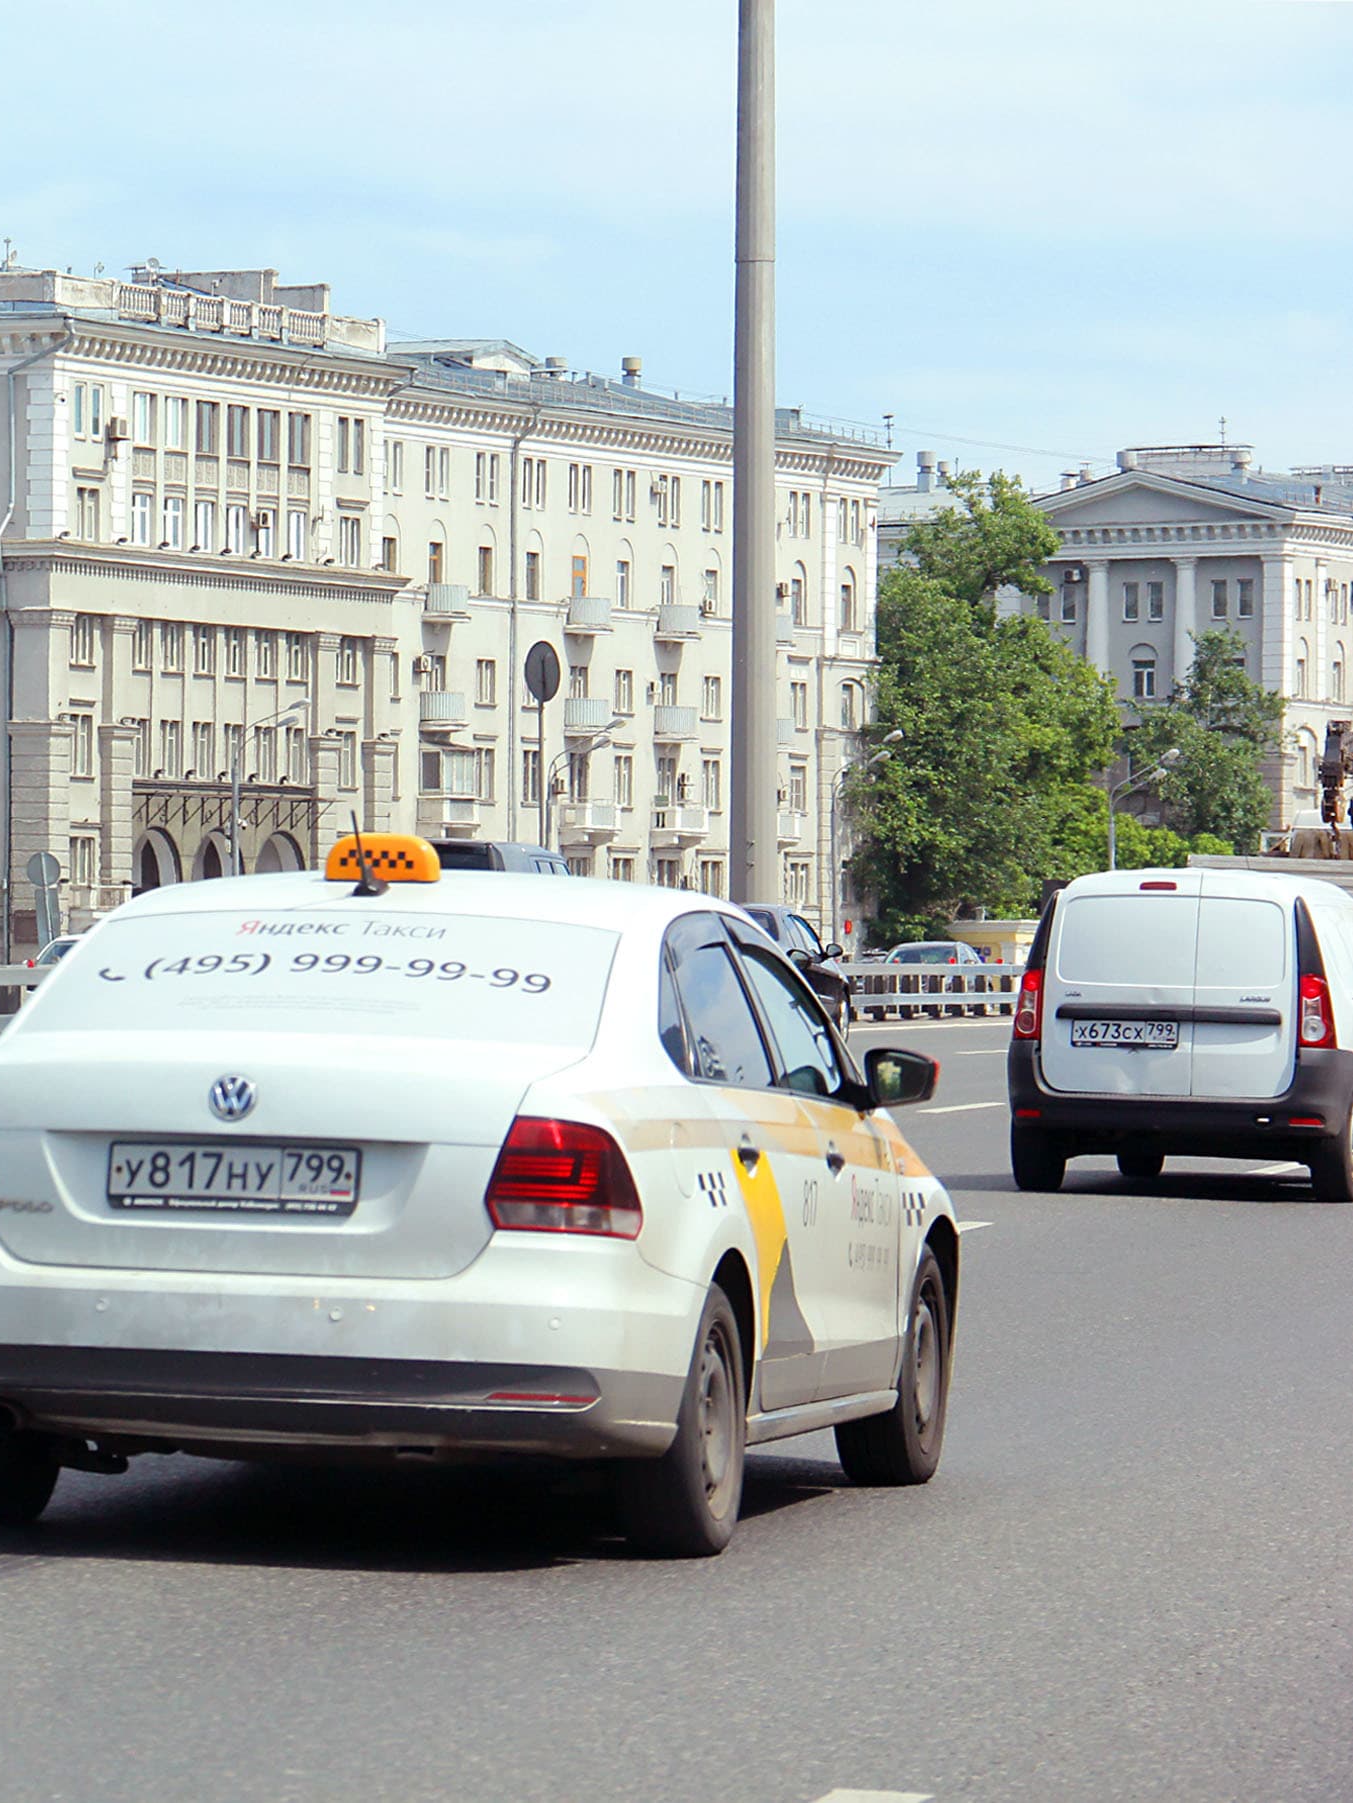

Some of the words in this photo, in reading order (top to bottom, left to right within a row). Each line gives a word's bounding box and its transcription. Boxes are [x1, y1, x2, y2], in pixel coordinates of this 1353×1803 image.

[235, 920, 351, 936] Яндекс
[362, 920, 447, 940] Такси
[144, 952, 272, 980] (495)
[289, 953, 552, 994] 999-99-99
[802, 1180, 818, 1228] 817
